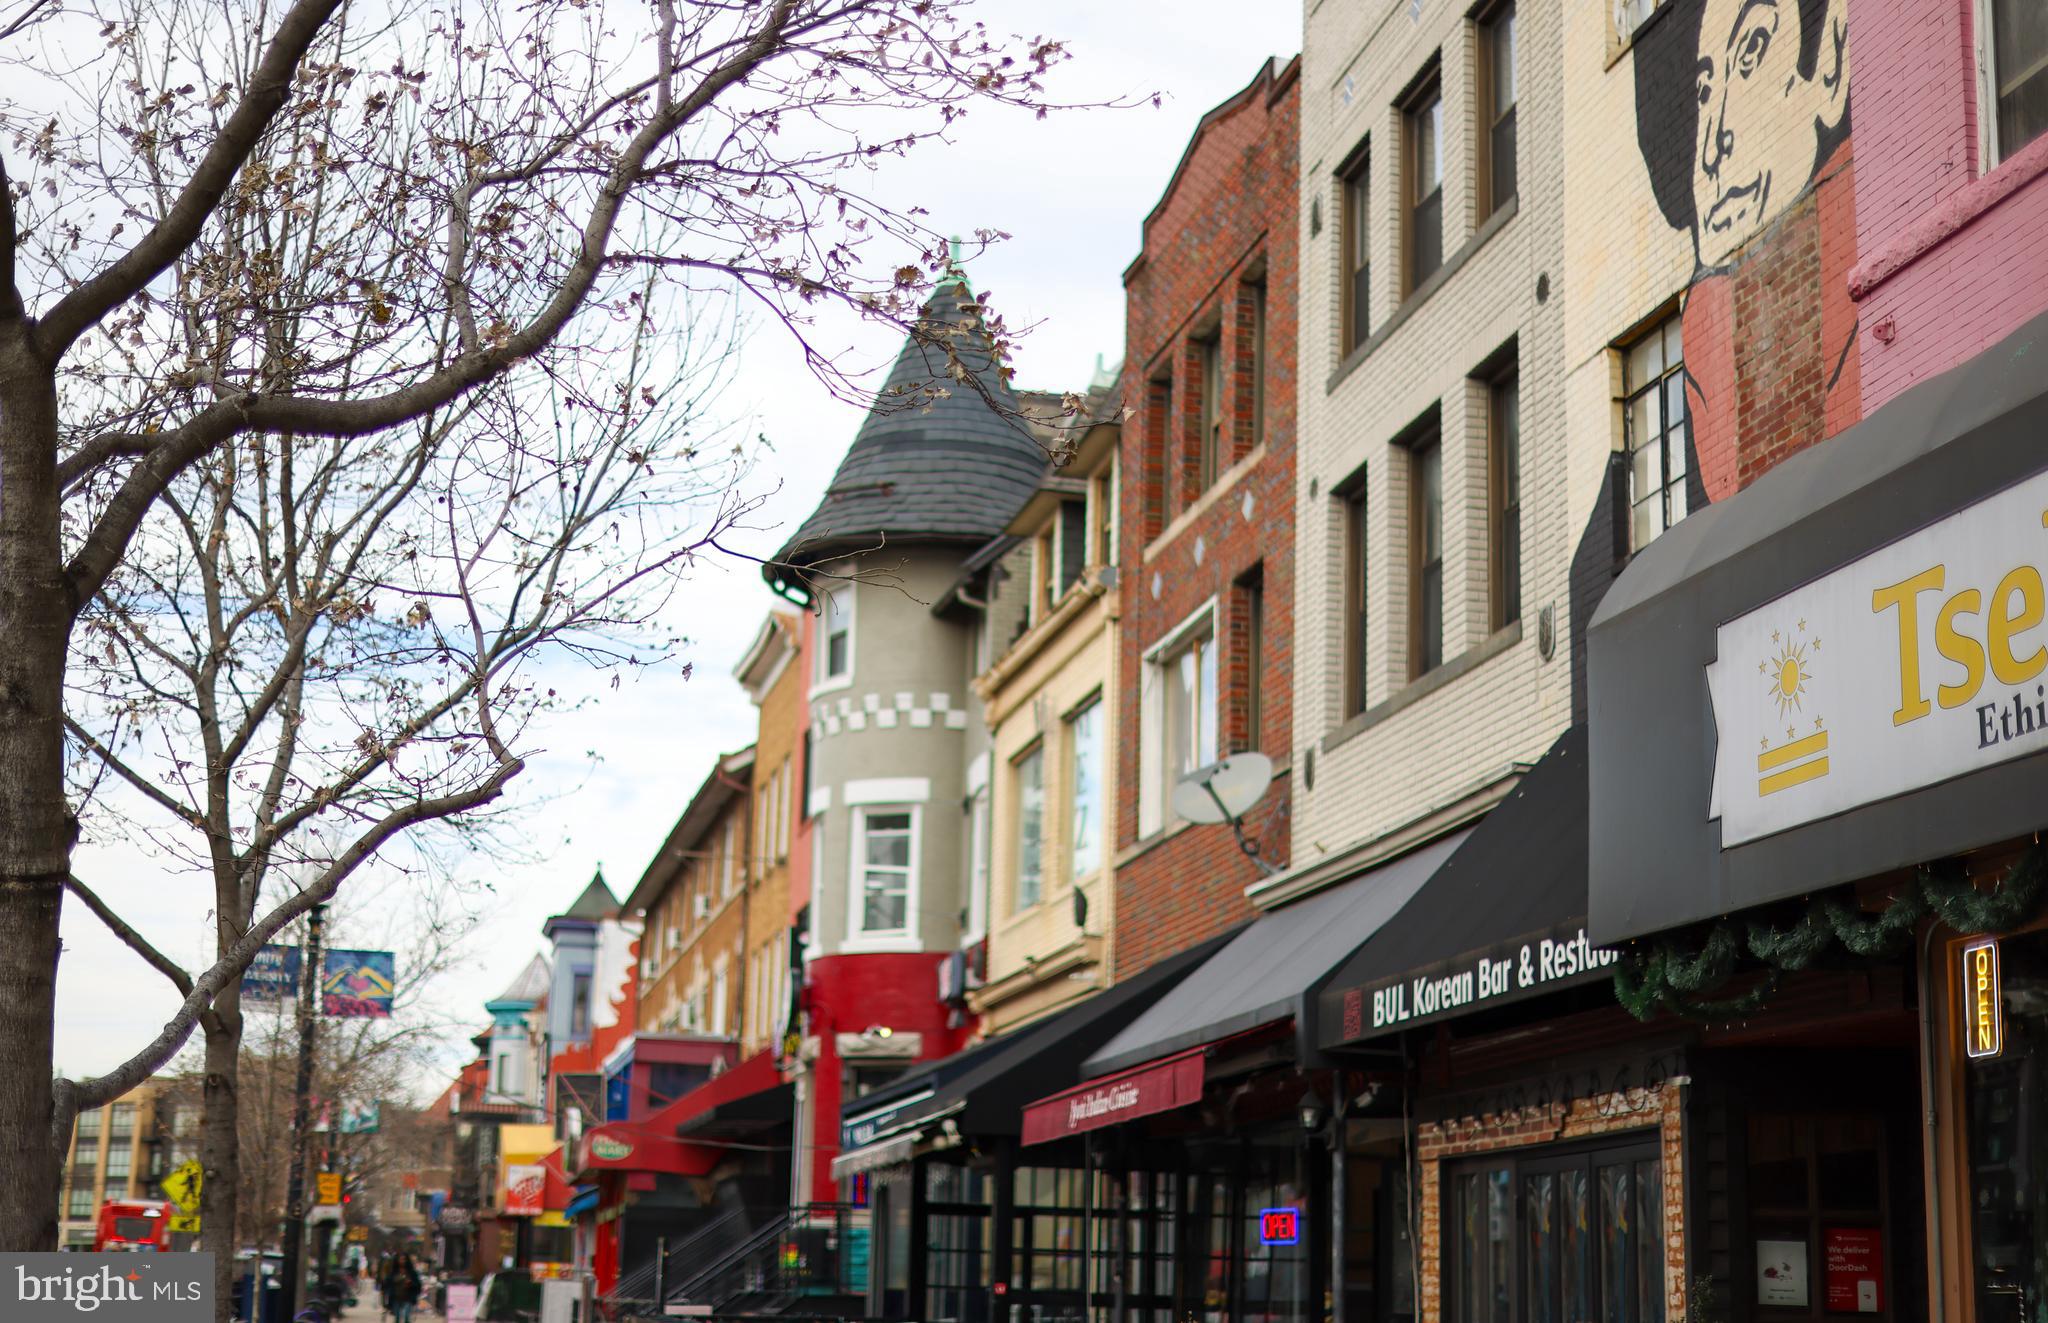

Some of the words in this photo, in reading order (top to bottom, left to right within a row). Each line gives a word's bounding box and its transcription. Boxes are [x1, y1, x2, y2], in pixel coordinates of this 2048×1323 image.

[1872, 511, 2048, 727] Tse
[1373, 983, 1410, 1028] BUL
[1413, 969, 1474, 1018] Korean
[1478, 957, 1512, 999] Bar
[1518, 944, 1535, 988] &
[1976, 951, 1991, 1051] OPEN
[1263, 1213, 1297, 1240] OPEN
[1826, 1245, 1841, 1254] We
[1827, 1263, 1869, 1272] DoorDash
